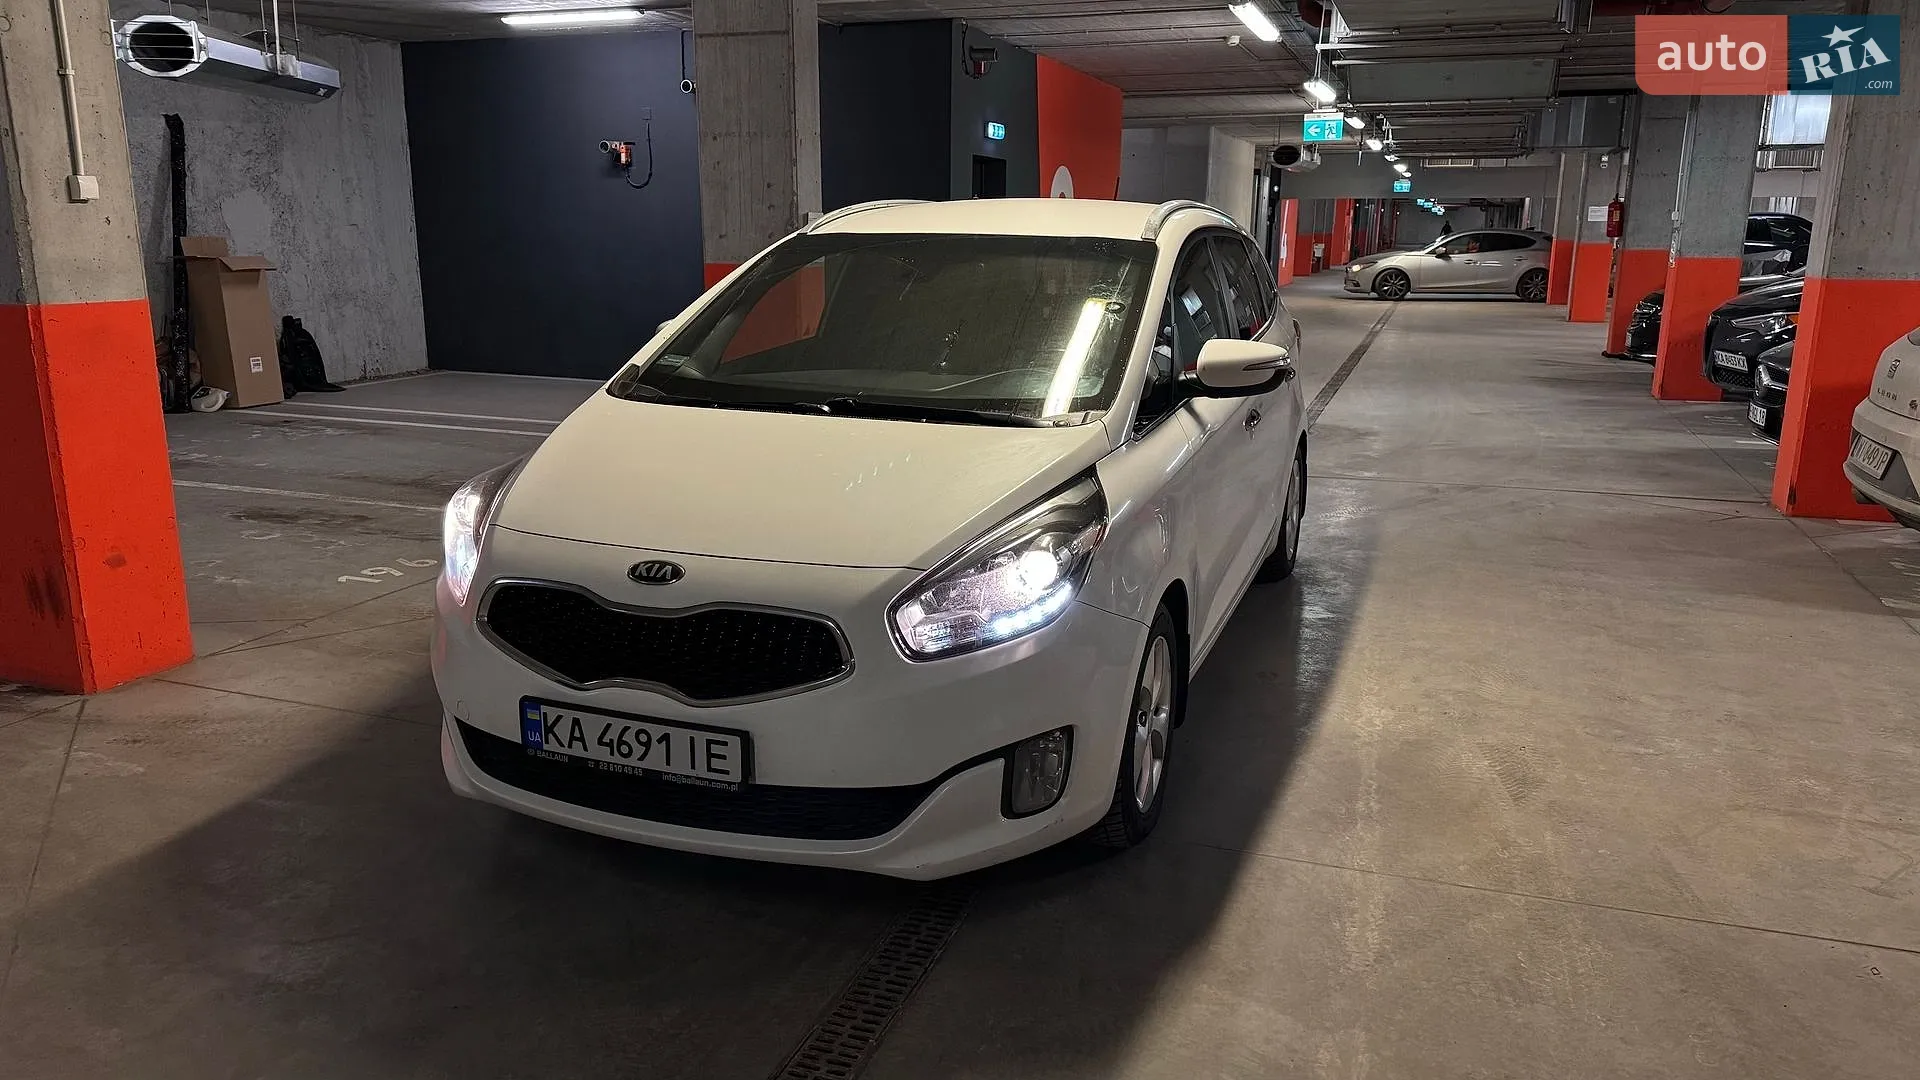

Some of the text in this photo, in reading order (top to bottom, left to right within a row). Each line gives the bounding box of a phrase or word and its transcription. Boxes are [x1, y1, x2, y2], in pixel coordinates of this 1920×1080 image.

[337, 557, 438, 583] 196
[634, 563, 673, 580] KIA
[528, 730, 542, 742] UA
[542, 711, 730, 776] KA 4691 IE
